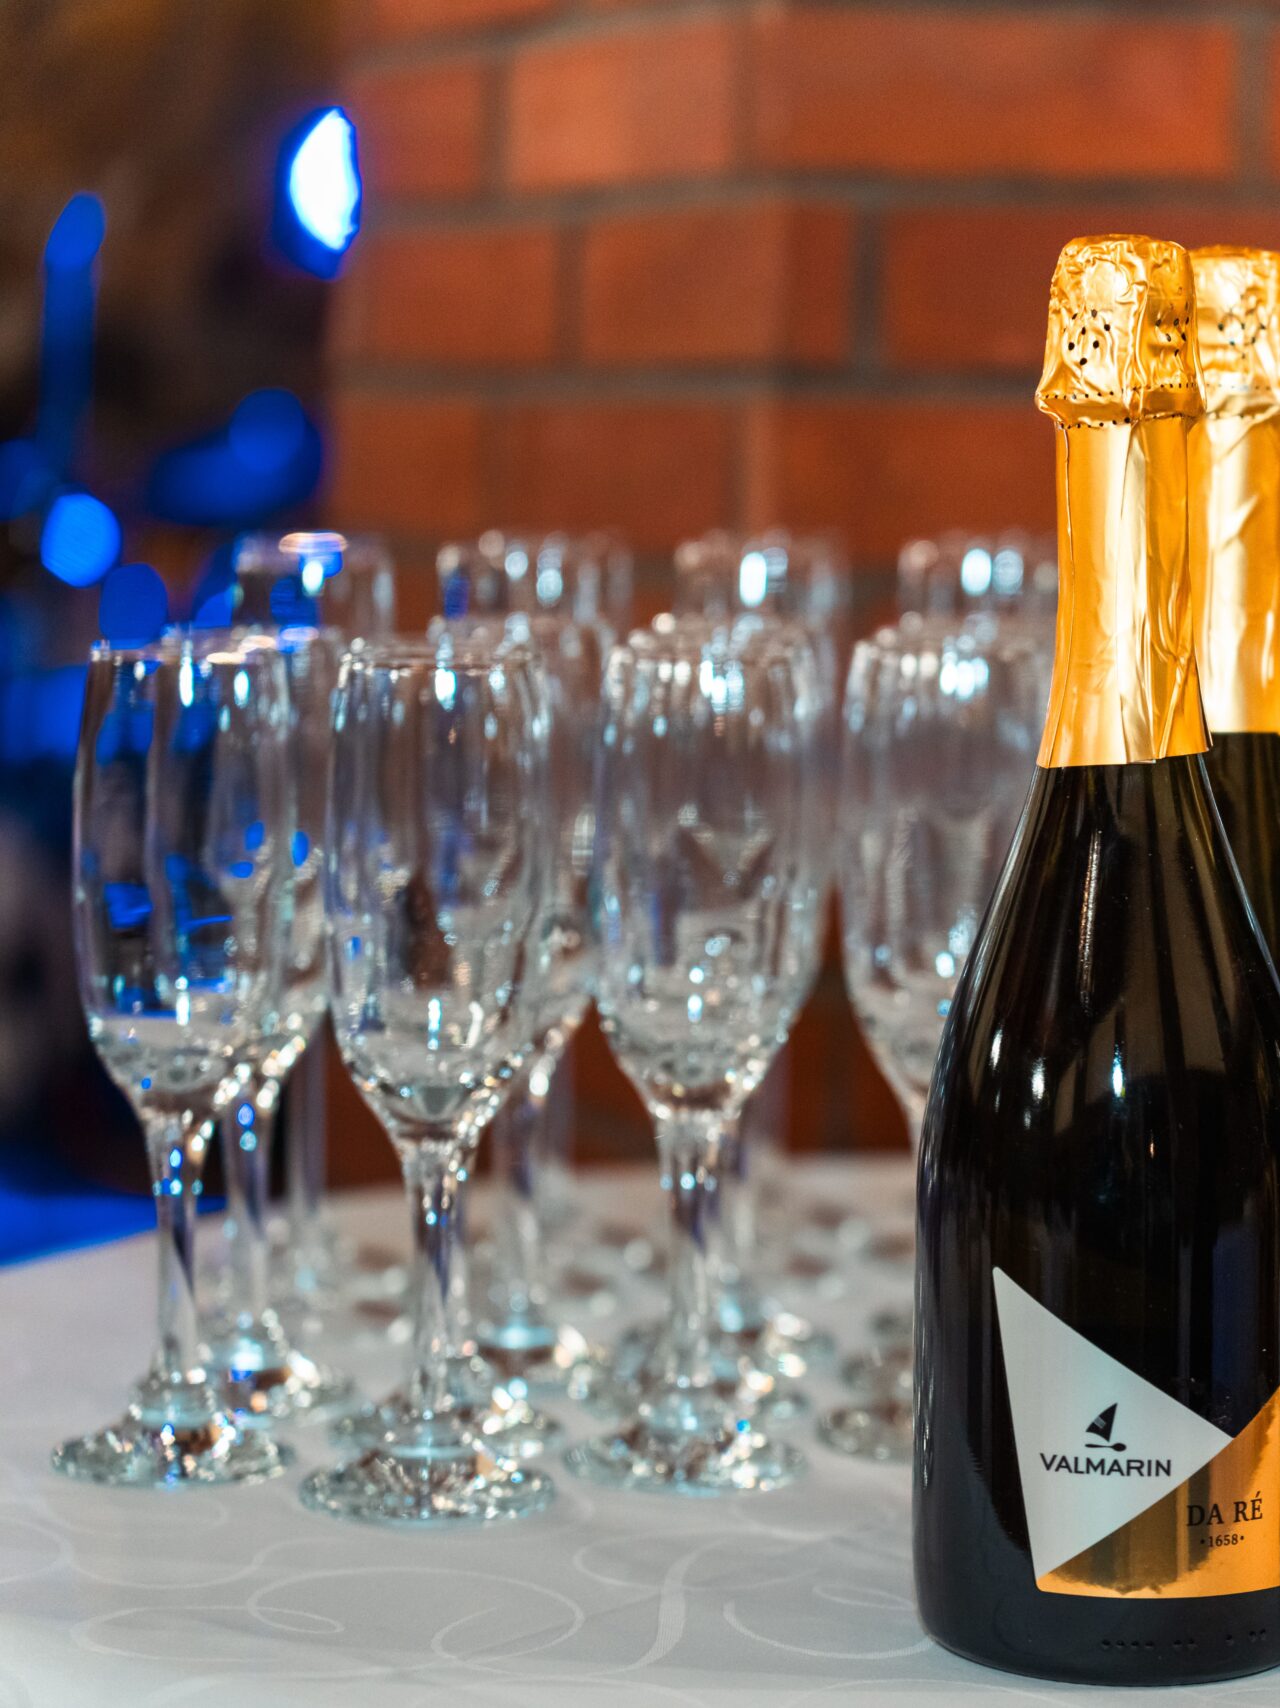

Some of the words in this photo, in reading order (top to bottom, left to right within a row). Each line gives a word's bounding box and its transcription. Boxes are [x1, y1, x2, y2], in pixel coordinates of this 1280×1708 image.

[1040, 1453, 1171, 1477] VALMARIN
[1186, 1503, 1224, 1527] DA
[1233, 1490, 1263, 1523] RÉ
